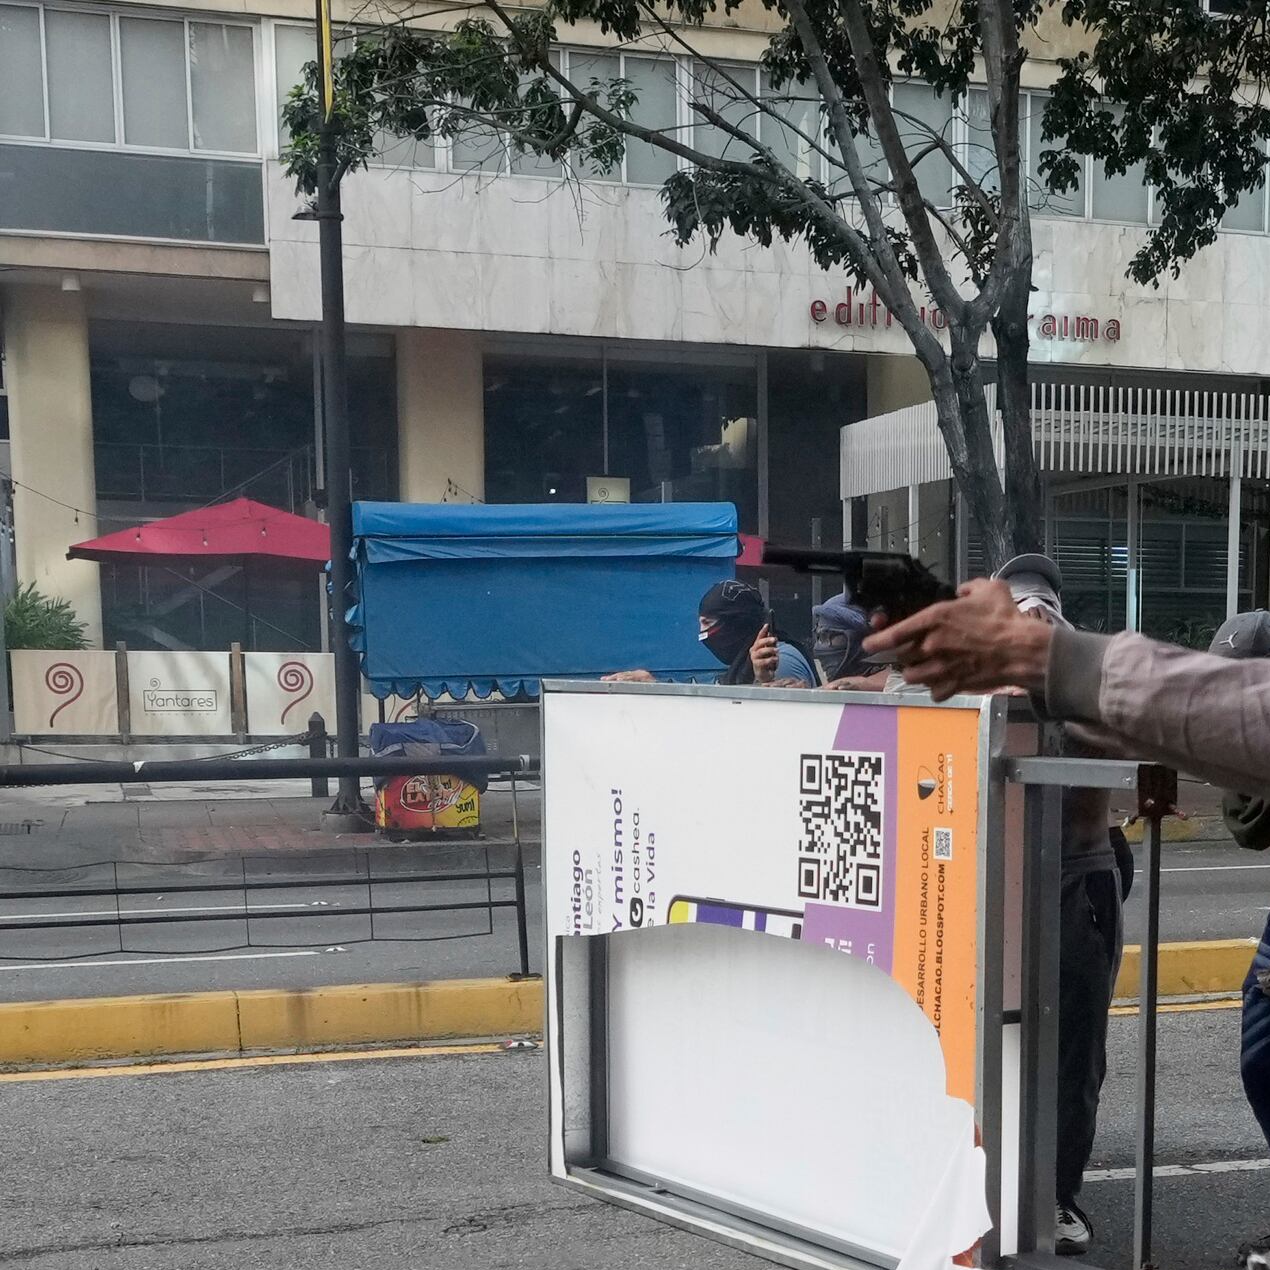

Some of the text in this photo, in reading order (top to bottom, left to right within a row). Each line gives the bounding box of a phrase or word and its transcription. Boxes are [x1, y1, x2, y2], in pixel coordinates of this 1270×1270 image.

[810, 286, 949, 330] edifiio
[146, 692, 214, 707] Yantares
[937, 753, 945, 815] CHACAO
[611, 788, 624, 904] mismo!
[645, 832, 656, 884] Vida
[921, 827, 929, 869] LOCAL
[583, 869, 593, 930] León
[646, 891, 655, 910] la
[920, 872, 929, 926] URBANO
